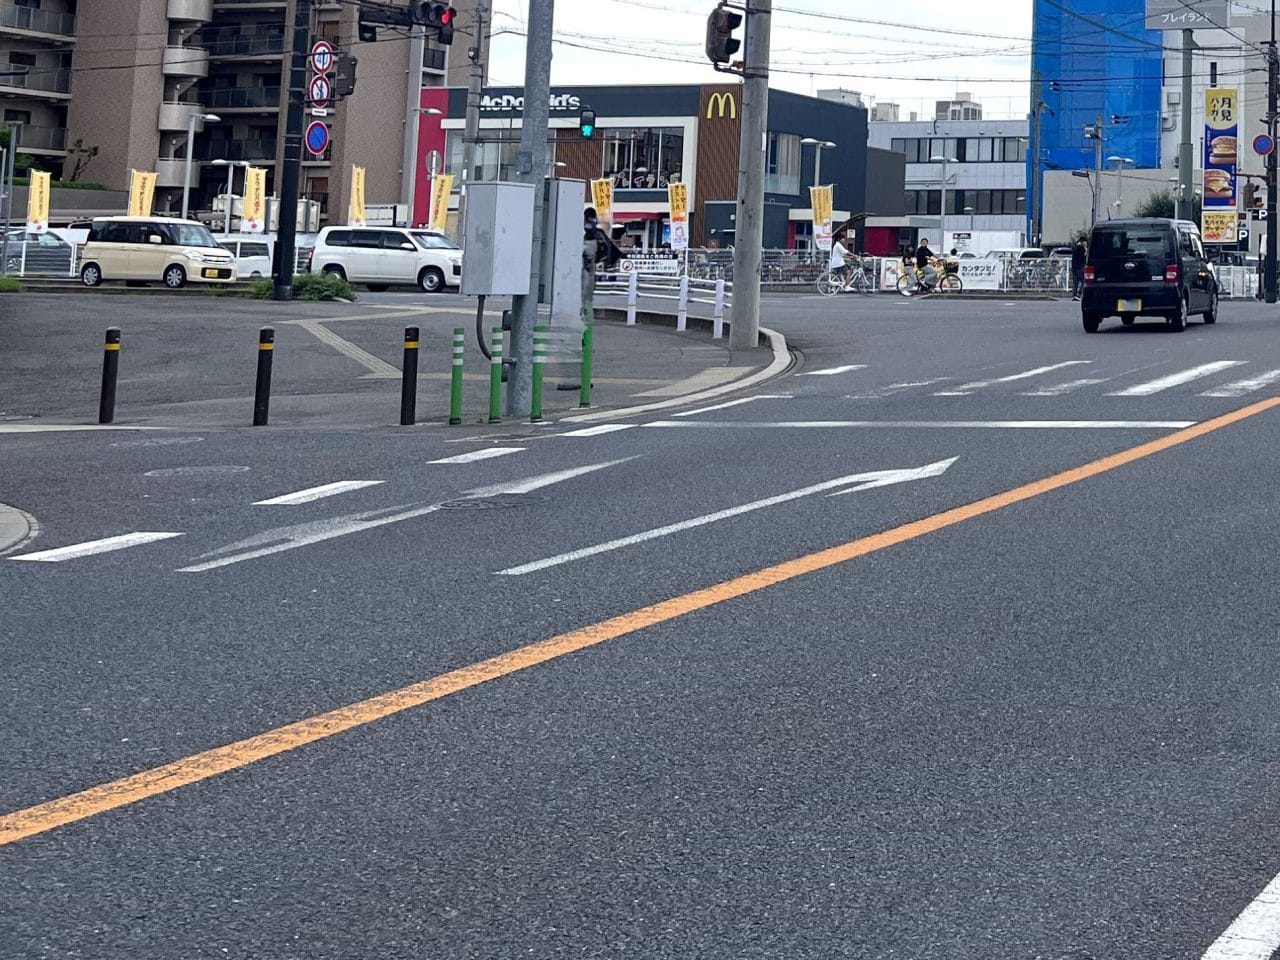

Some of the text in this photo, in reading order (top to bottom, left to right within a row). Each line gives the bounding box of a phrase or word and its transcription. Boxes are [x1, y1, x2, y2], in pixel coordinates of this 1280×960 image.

[480, 94, 580, 111] McDold's
[1220, 97, 1232, 122] 月見
[1238, 230, 1248, 241] P
